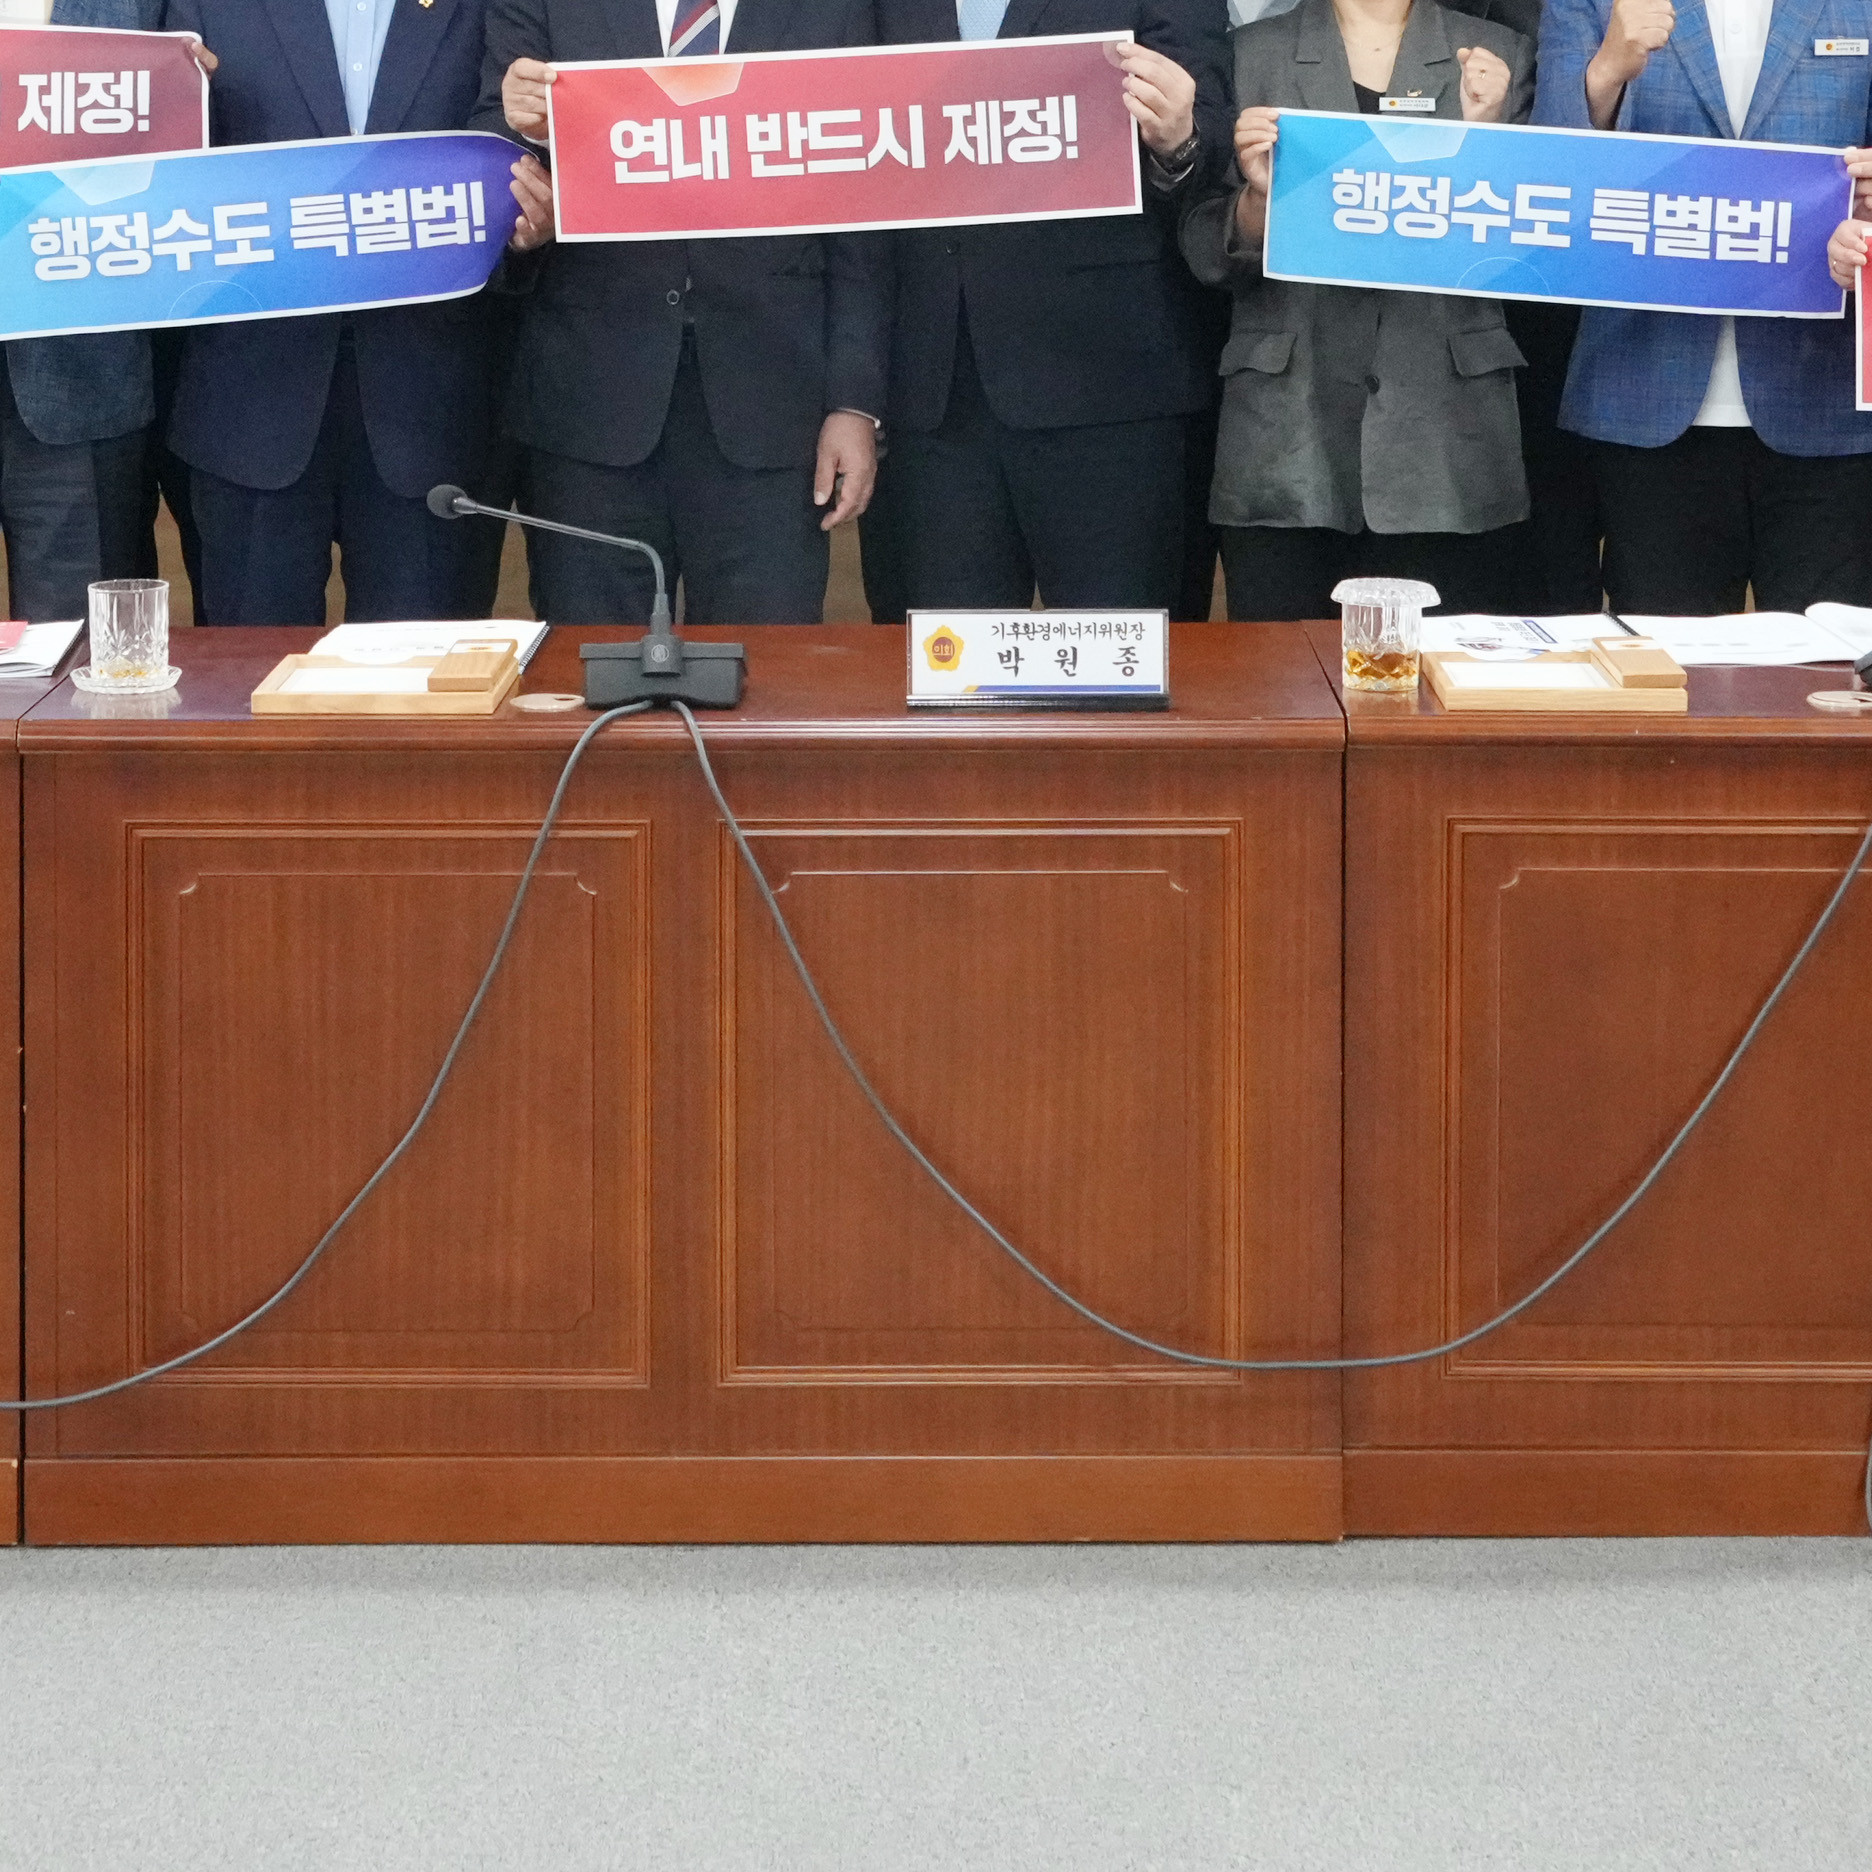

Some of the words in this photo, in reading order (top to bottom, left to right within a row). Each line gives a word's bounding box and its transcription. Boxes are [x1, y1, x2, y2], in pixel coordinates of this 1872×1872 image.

[18, 70, 150, 134] 제정!
[610, 115, 729, 183] 연내
[746, 105, 925, 177] 반드시
[943, 95, 1078, 164] 제정!
[28, 202, 274, 281] 행정수도
[290, 181, 485, 256] 특별법!
[1333, 169, 1571, 247] 행정수도
[1590, 189, 1792, 263] 특별법!
[992, 622, 1145, 641] 기후환경에너지위원장
[998, 646, 1139, 677] 박원종
